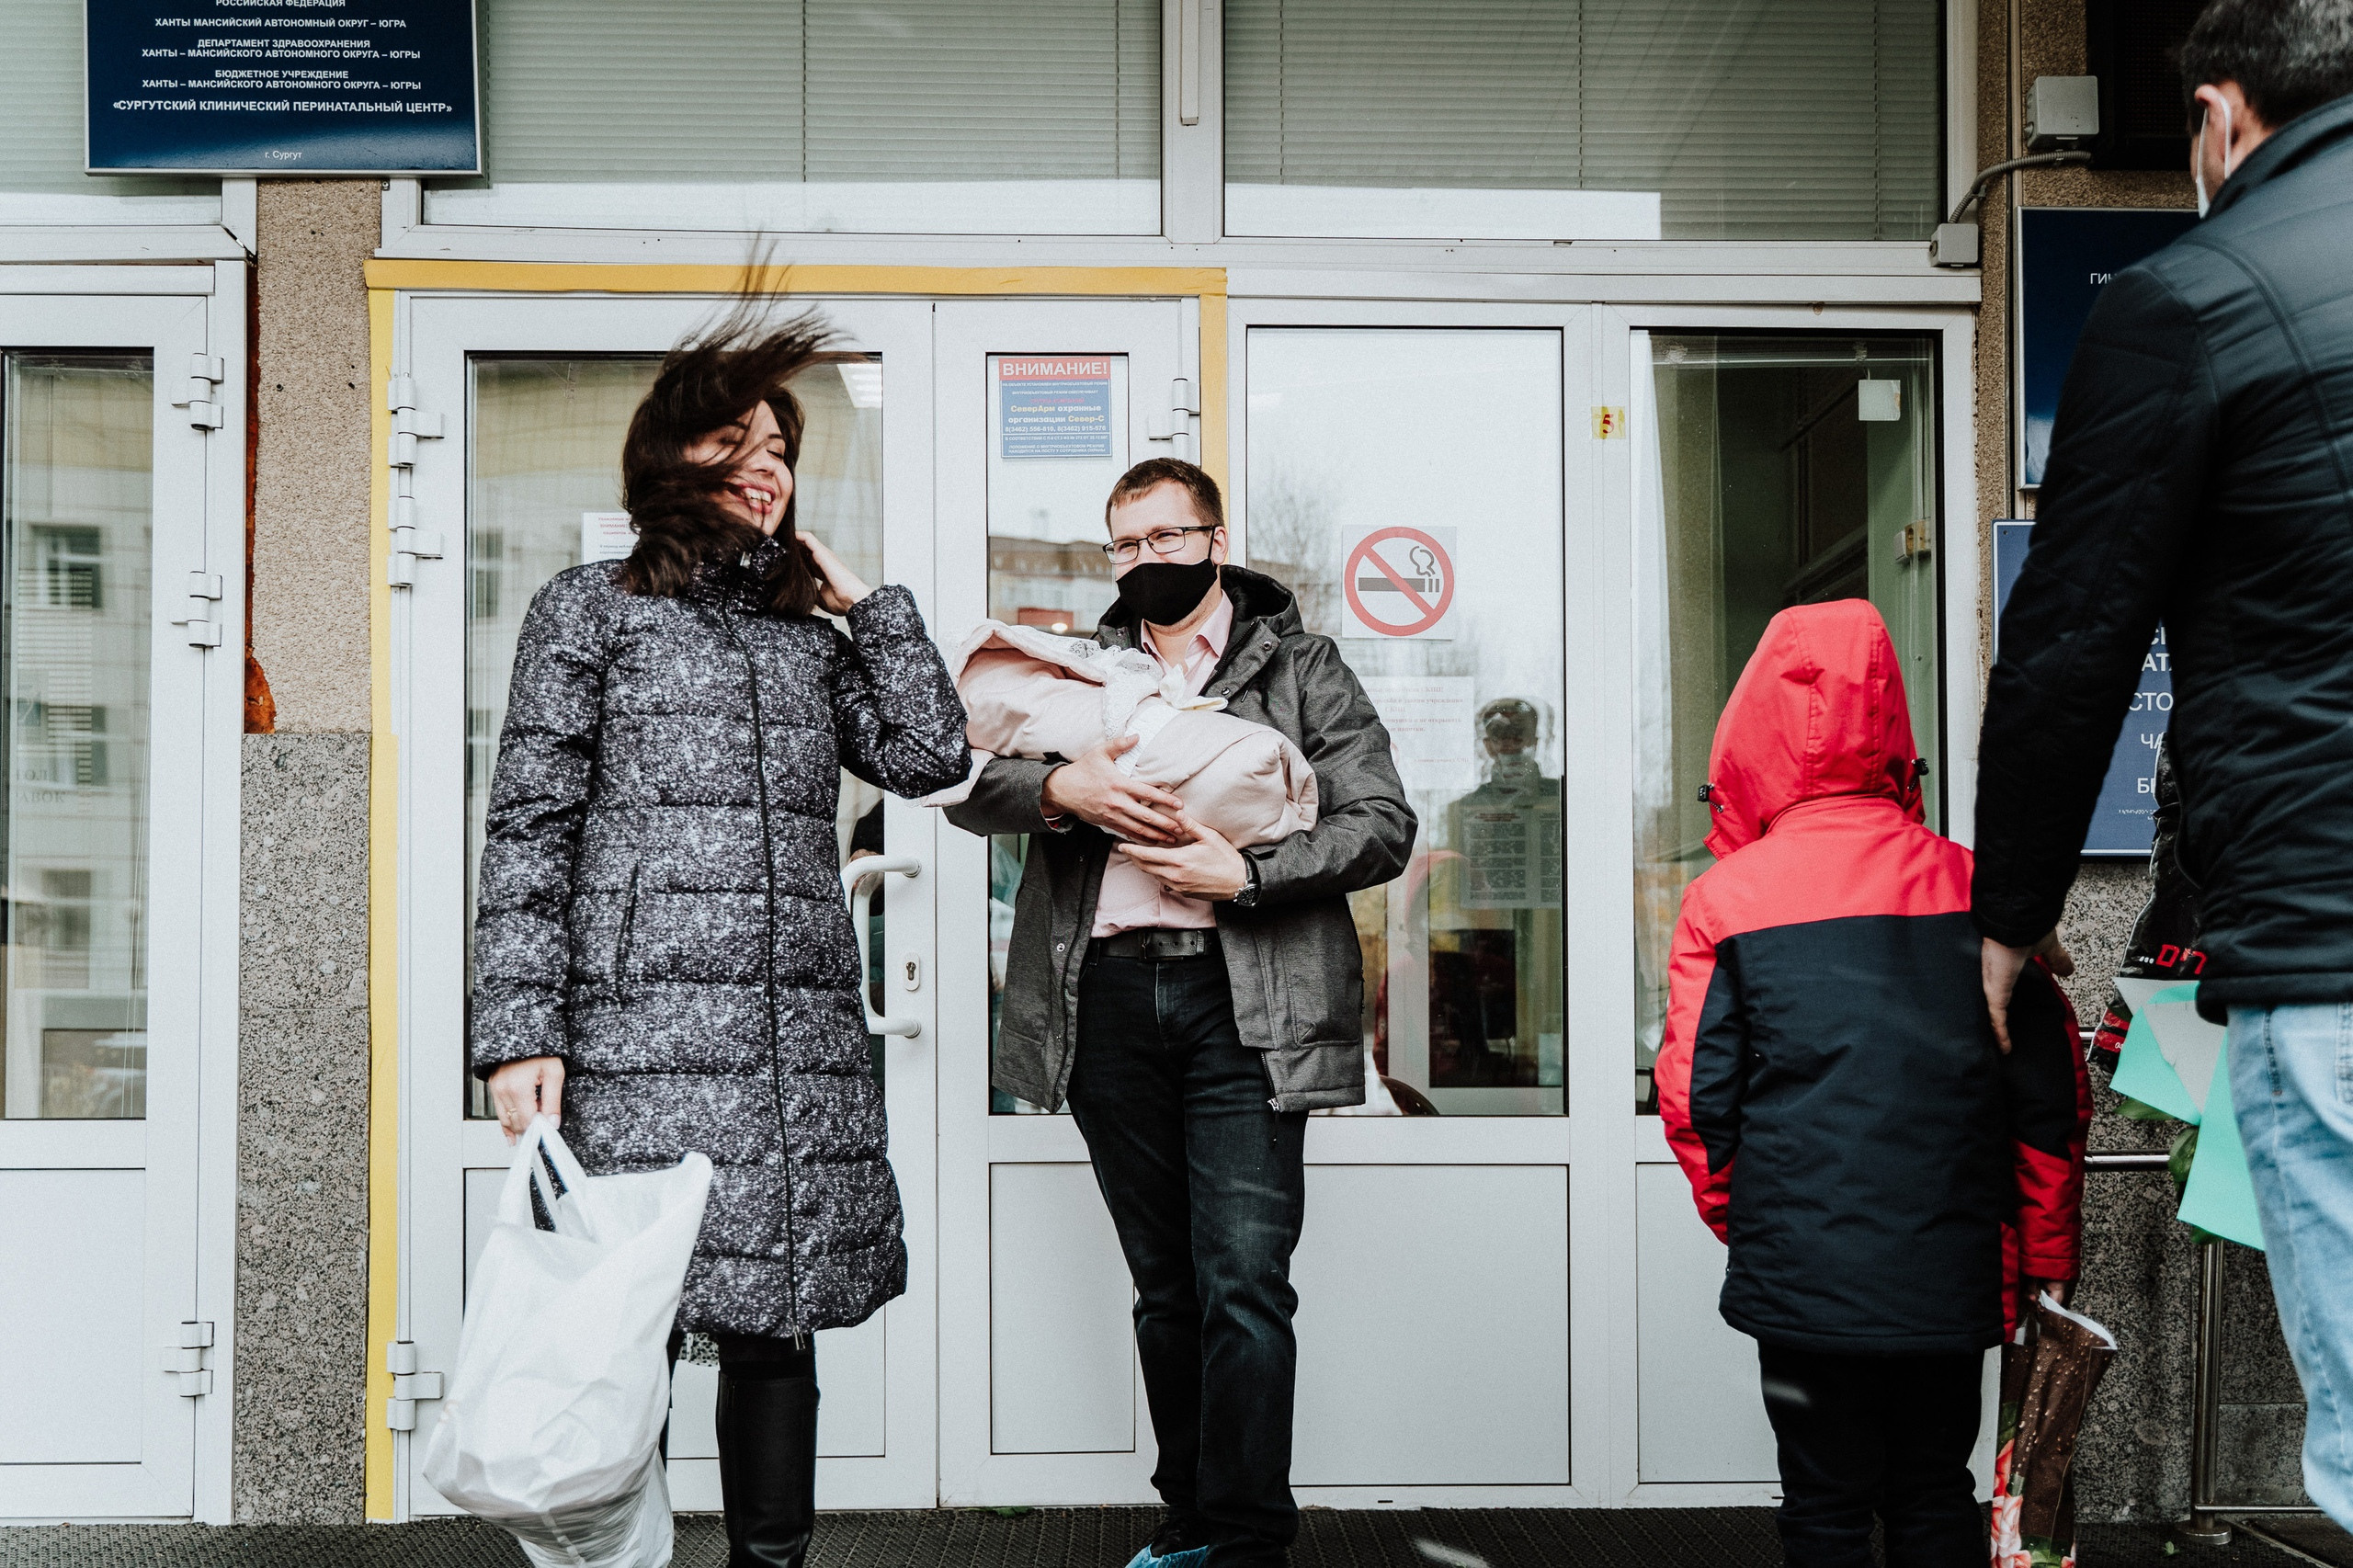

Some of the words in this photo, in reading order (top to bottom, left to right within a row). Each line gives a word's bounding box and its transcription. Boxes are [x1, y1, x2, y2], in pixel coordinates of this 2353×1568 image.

[155, 18, 191, 27] ХАНТЫ
[193, 17, 262, 28] МАНСИЙСКИЙ
[264, 17, 335, 28] АВТОНОМНЫЙ
[337, 18, 369, 28] ОКРУГ
[379, 19, 407, 28] ЮГРА
[198, 39, 270, 49] ДЕПАРТАМЕНТ
[272, 40, 370, 49] ЗДРАВООХРАНЕНИЯ
[142, 49, 178, 58] ХАНТЫ
[188, 48, 263, 58] МАНСИЙСКОГО
[265, 50, 341, 59] АВТОНОМНОГО
[342, 50, 380, 59] ОКРУГА
[390, 51, 421, 59] ЮГРЫ
[215, 70, 279, 80] БЮДЖЕТНОЕ
[281, 70, 349, 80] УЧРЕЖДЕНИЕ
[142, 80, 178, 88] ХАНТЫ
[188, 78, 263, 89] МАНСИЙСКОГО
[265, 80, 341, 90] АВТОНОМНОГО
[343, 81, 381, 90] ОКРУГА
[390, 81, 422, 90] ЮГРЫ
[113, 98, 197, 110] «СУРГУТСКИЙ
[199, 99, 290, 111] КЛИНИЧЕСКИЙ
[293, 100, 404, 112] ПЕРИНАТАЛЬНЫЙ
[406, 102, 453, 114] ЦЕНТР»
[272, 150, 302, 161] Сургут
[1003, 362, 1108, 376] ВНИМАНИЕ!
[1602, 414, 1615, 434] 5
